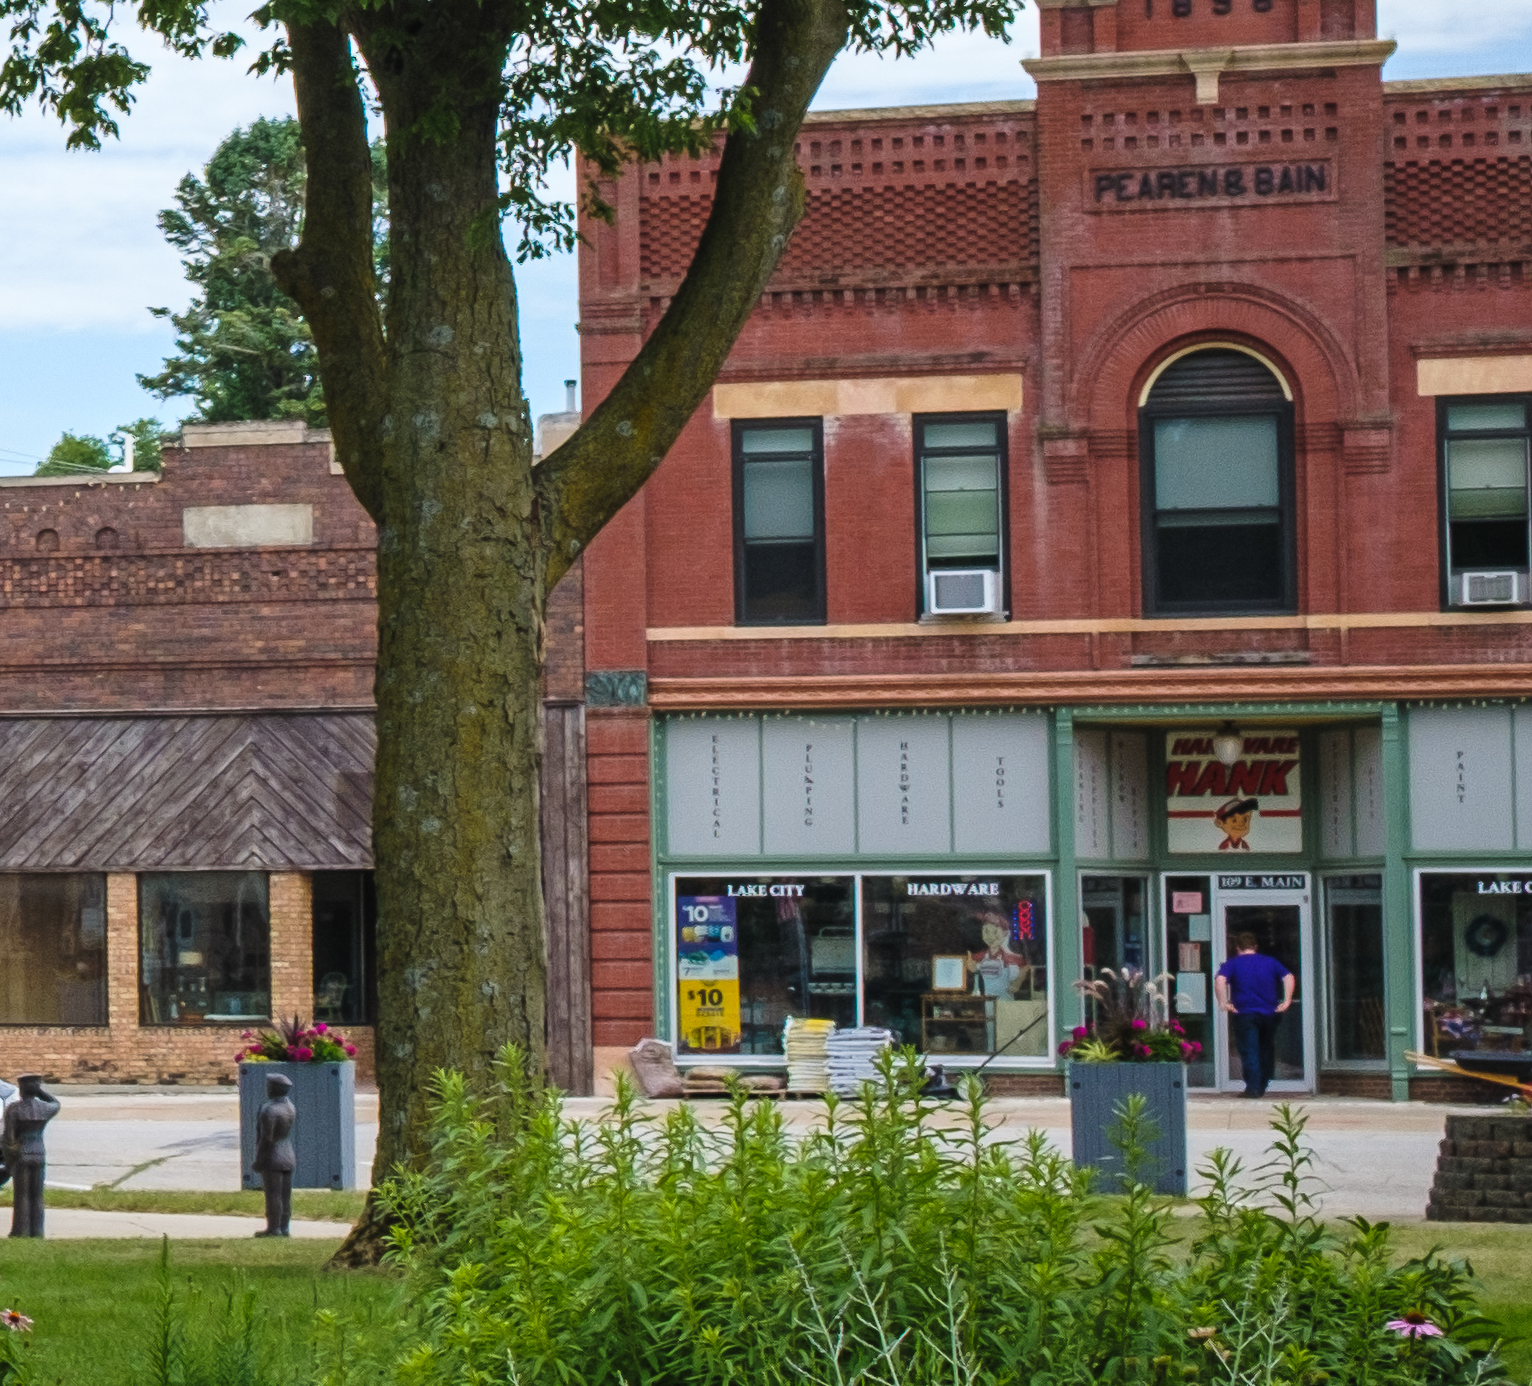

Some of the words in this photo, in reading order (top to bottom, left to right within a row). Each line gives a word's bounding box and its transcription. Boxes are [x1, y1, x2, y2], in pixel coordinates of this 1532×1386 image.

[1094, 168, 1218, 202] PEAREN
[1224, 168, 1247, 196] &
[1255, 164, 1325, 196] BAIN
[712, 735, 721, 838] ELECTRICAL
[804, 744, 814, 826] PLUMBING
[899, 741, 911, 824] HARDWARE
[996, 757, 1005, 808] TOOLS
[1167, 760, 1298, 796] HANK
[1457, 750, 1465, 803] PAINT
[727, 885, 767, 897] LAKE
[770, 884, 805, 897] CITY
[907, 883, 1000, 896] HARDWARE
[1261, 876, 1303, 888] MAIN
[1477, 881, 1522, 894] LAKE
